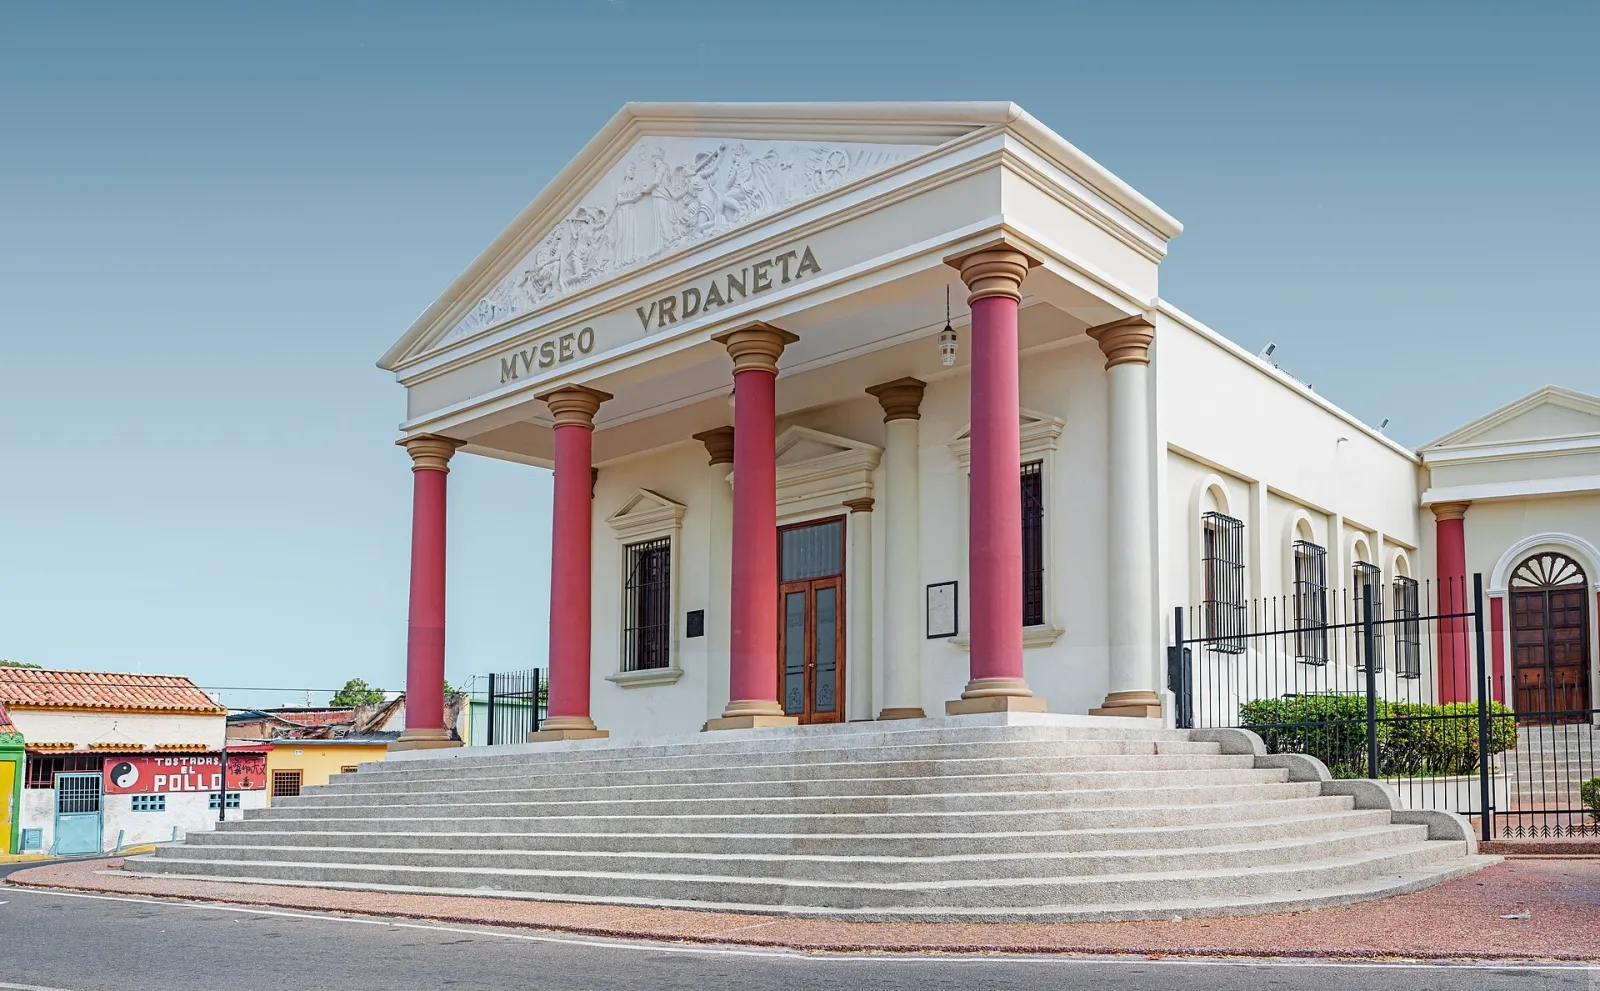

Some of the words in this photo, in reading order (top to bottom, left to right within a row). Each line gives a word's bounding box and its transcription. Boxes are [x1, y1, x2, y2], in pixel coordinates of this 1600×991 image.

[500, 326, 595, 384] MVSEO
[636, 245, 822, 332] VRDANETA
[181, 765, 196, 775] EL
[153, 773, 222, 792] POLLO
